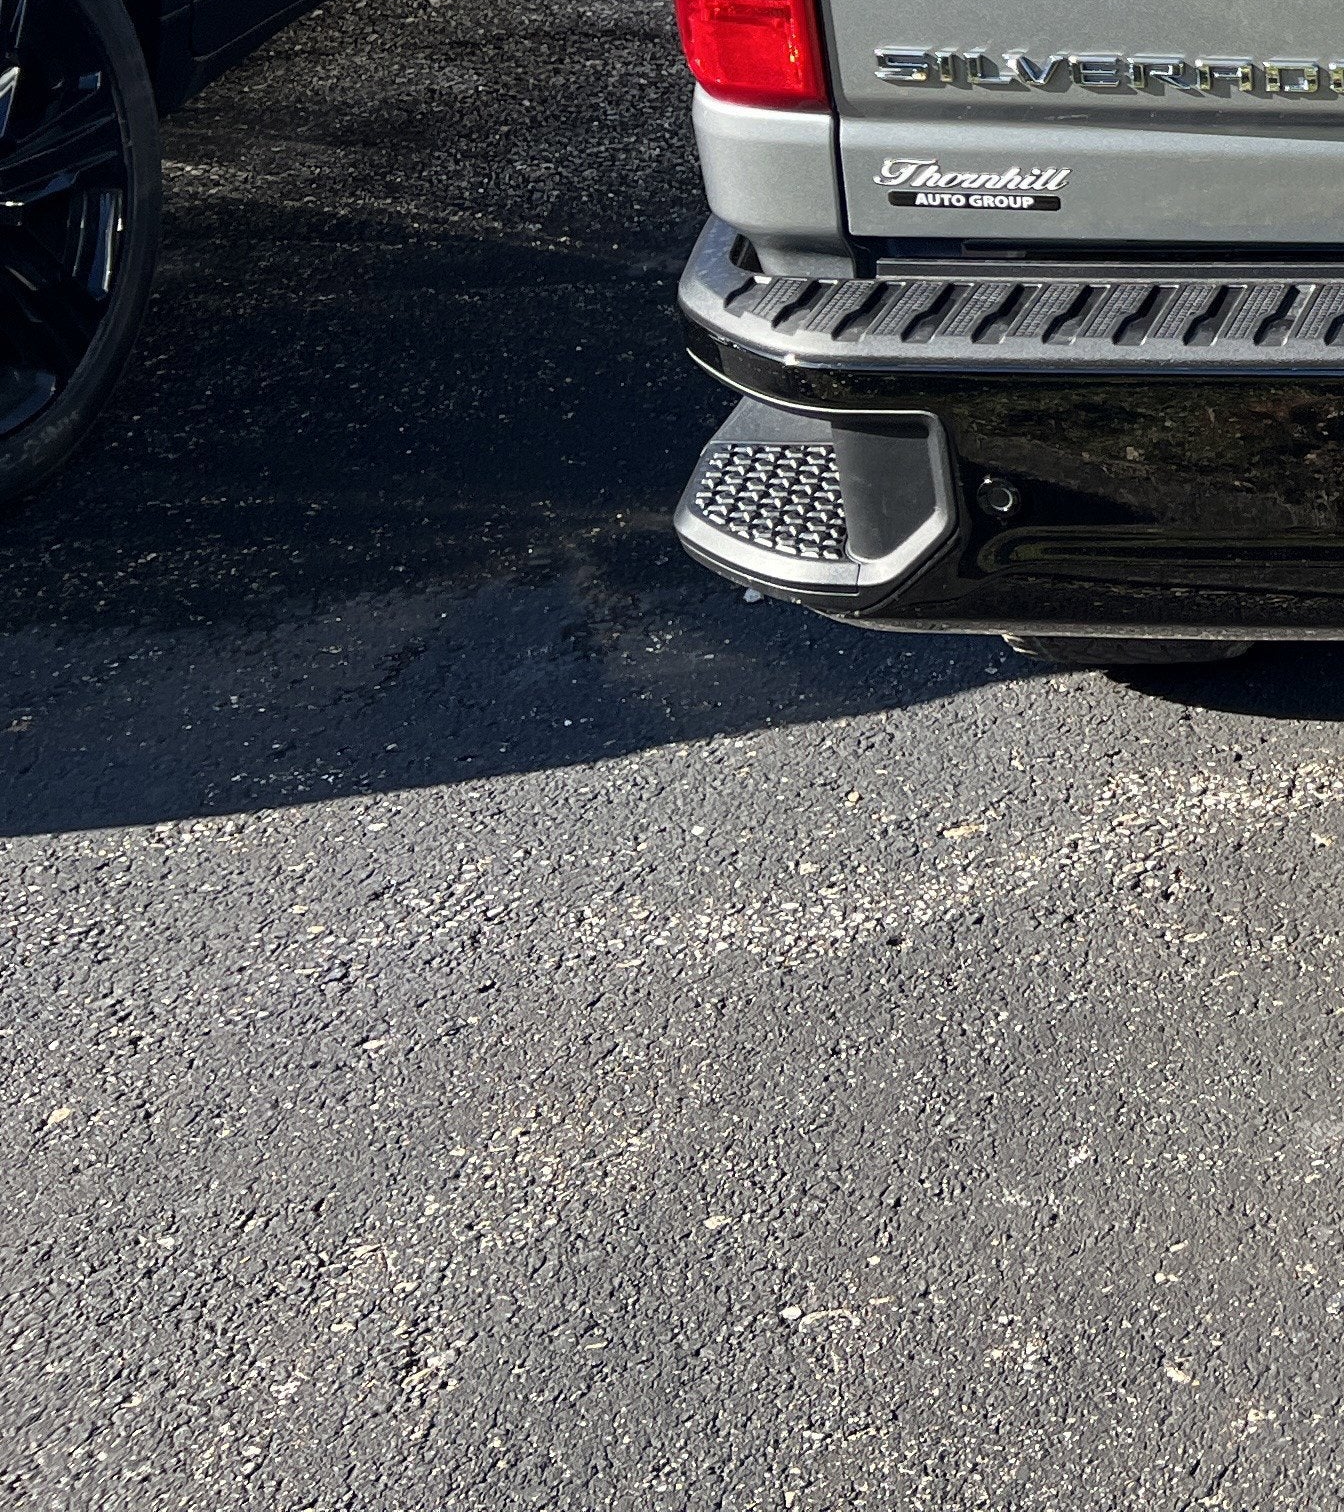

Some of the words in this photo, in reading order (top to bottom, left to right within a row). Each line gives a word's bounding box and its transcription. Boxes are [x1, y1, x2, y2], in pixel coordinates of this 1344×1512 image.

[872, 157, 1073, 191] Thornhill
[915, 192, 966, 206] AUTO
[968, 194, 1035, 208] GROUP
